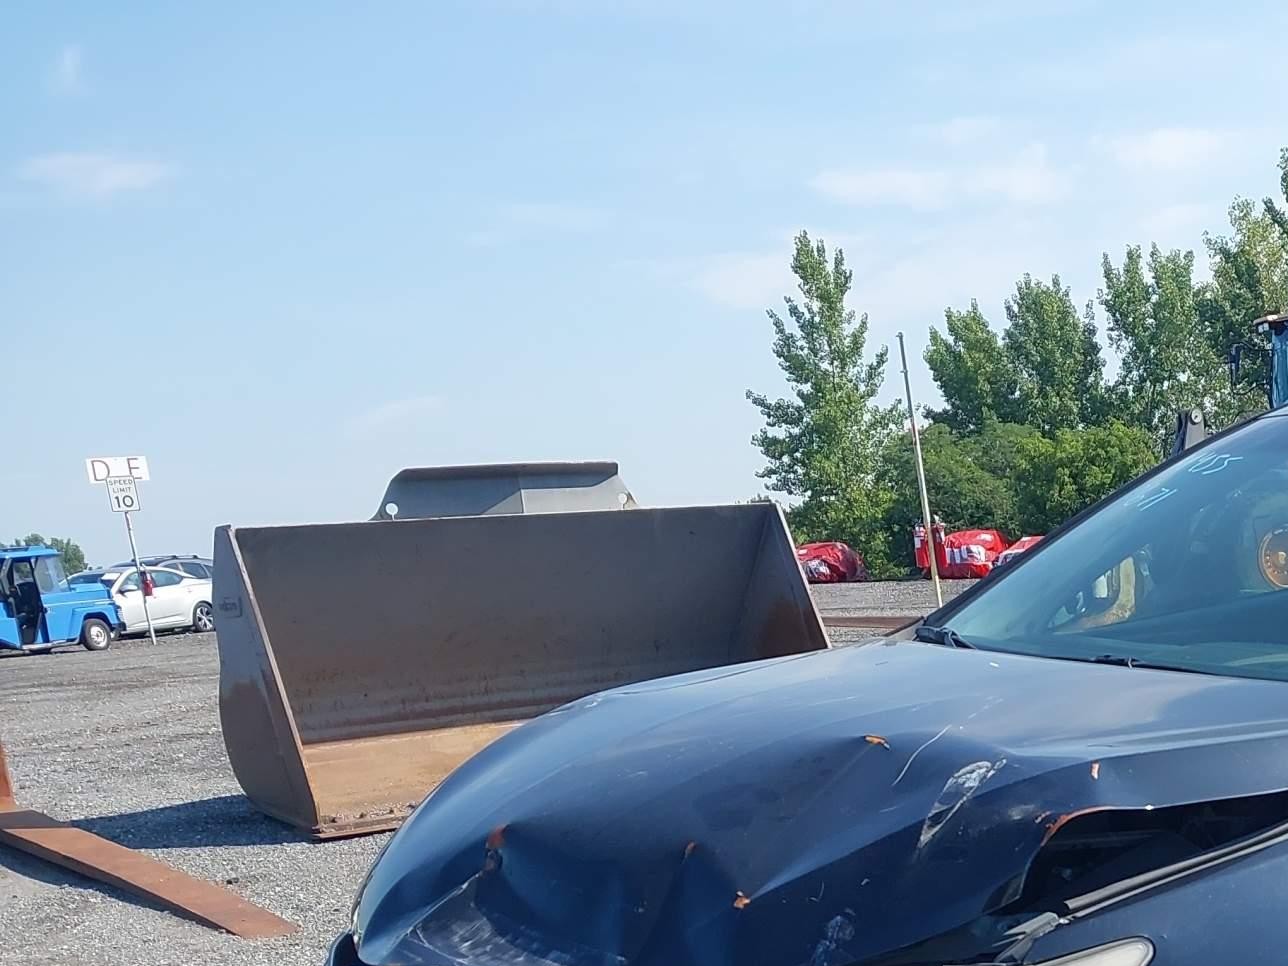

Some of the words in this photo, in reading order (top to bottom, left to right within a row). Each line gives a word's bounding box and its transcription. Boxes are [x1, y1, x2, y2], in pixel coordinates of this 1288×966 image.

[90, 459, 110, 481] D
[127, 457, 143, 480] E
[112, 486, 132, 494] LIMIT
[114, 495, 135, 509] 10
